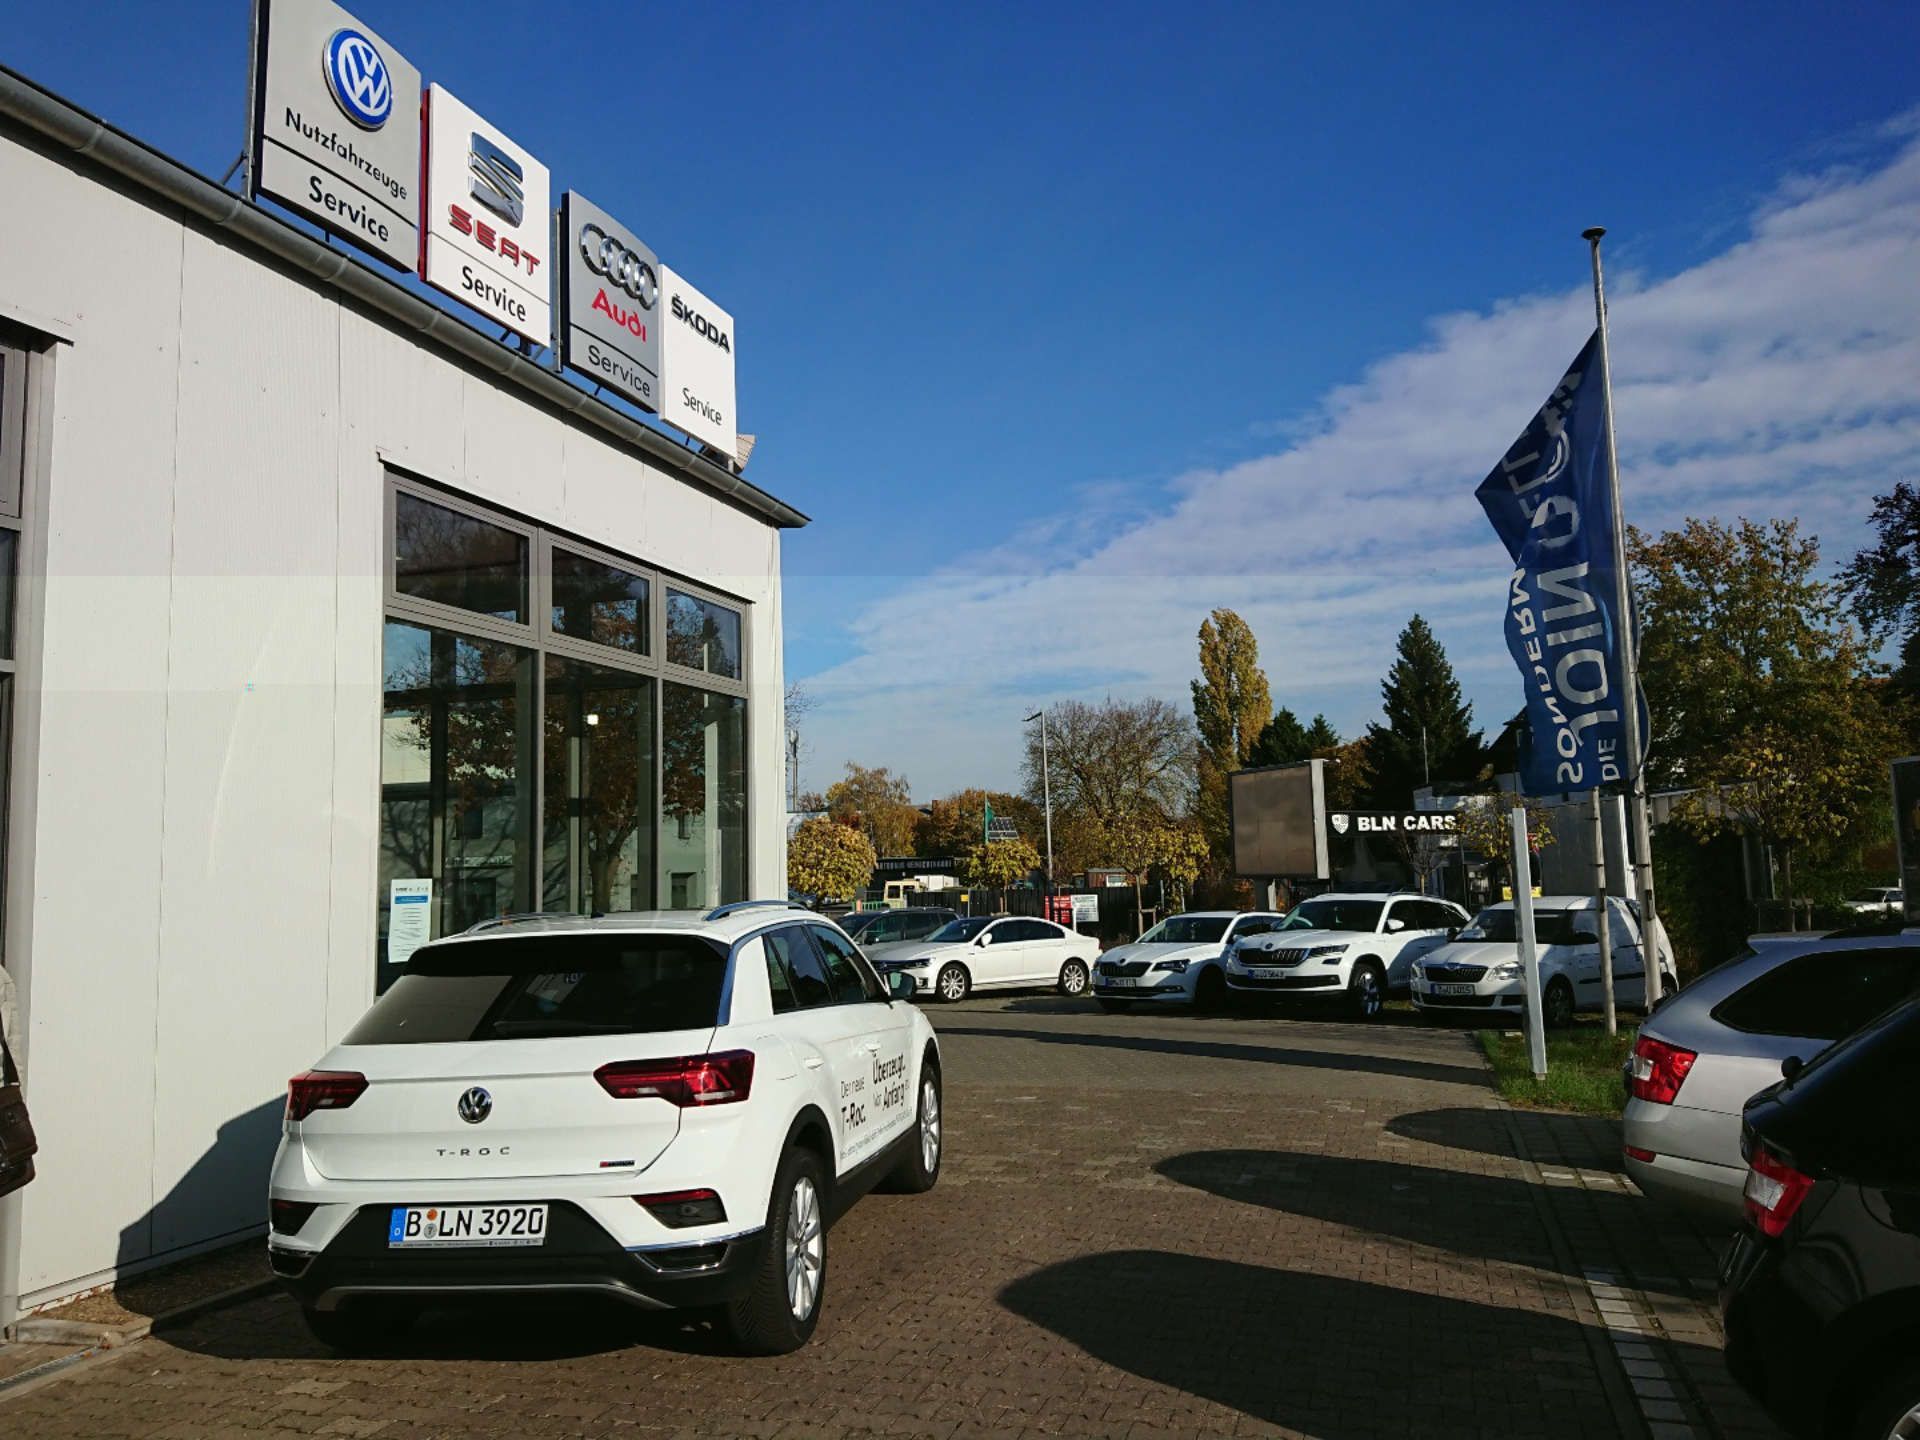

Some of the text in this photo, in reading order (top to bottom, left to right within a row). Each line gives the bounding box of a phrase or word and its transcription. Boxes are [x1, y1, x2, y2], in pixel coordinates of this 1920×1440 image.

[286, 107, 407, 200] Nutzfahrzeuge
[309, 175, 390, 243] Service
[448, 203, 540, 277] SEAT
[462, 266, 526, 322] Service
[592, 288, 646, 343] Audi
[671, 293, 732, 354] ŠKODA
[588, 345, 651, 398] Service
[682, 387, 722, 426] Service
[1357, 815, 1456, 831] BLN CARS
[883, 1082, 905, 1111] Anfang
[437, 1146, 511, 1157] T-ROC
[405, 1210, 422, 1237] B
[438, 1209, 473, 1237] LN
[479, 1207, 544, 1237] 3920
